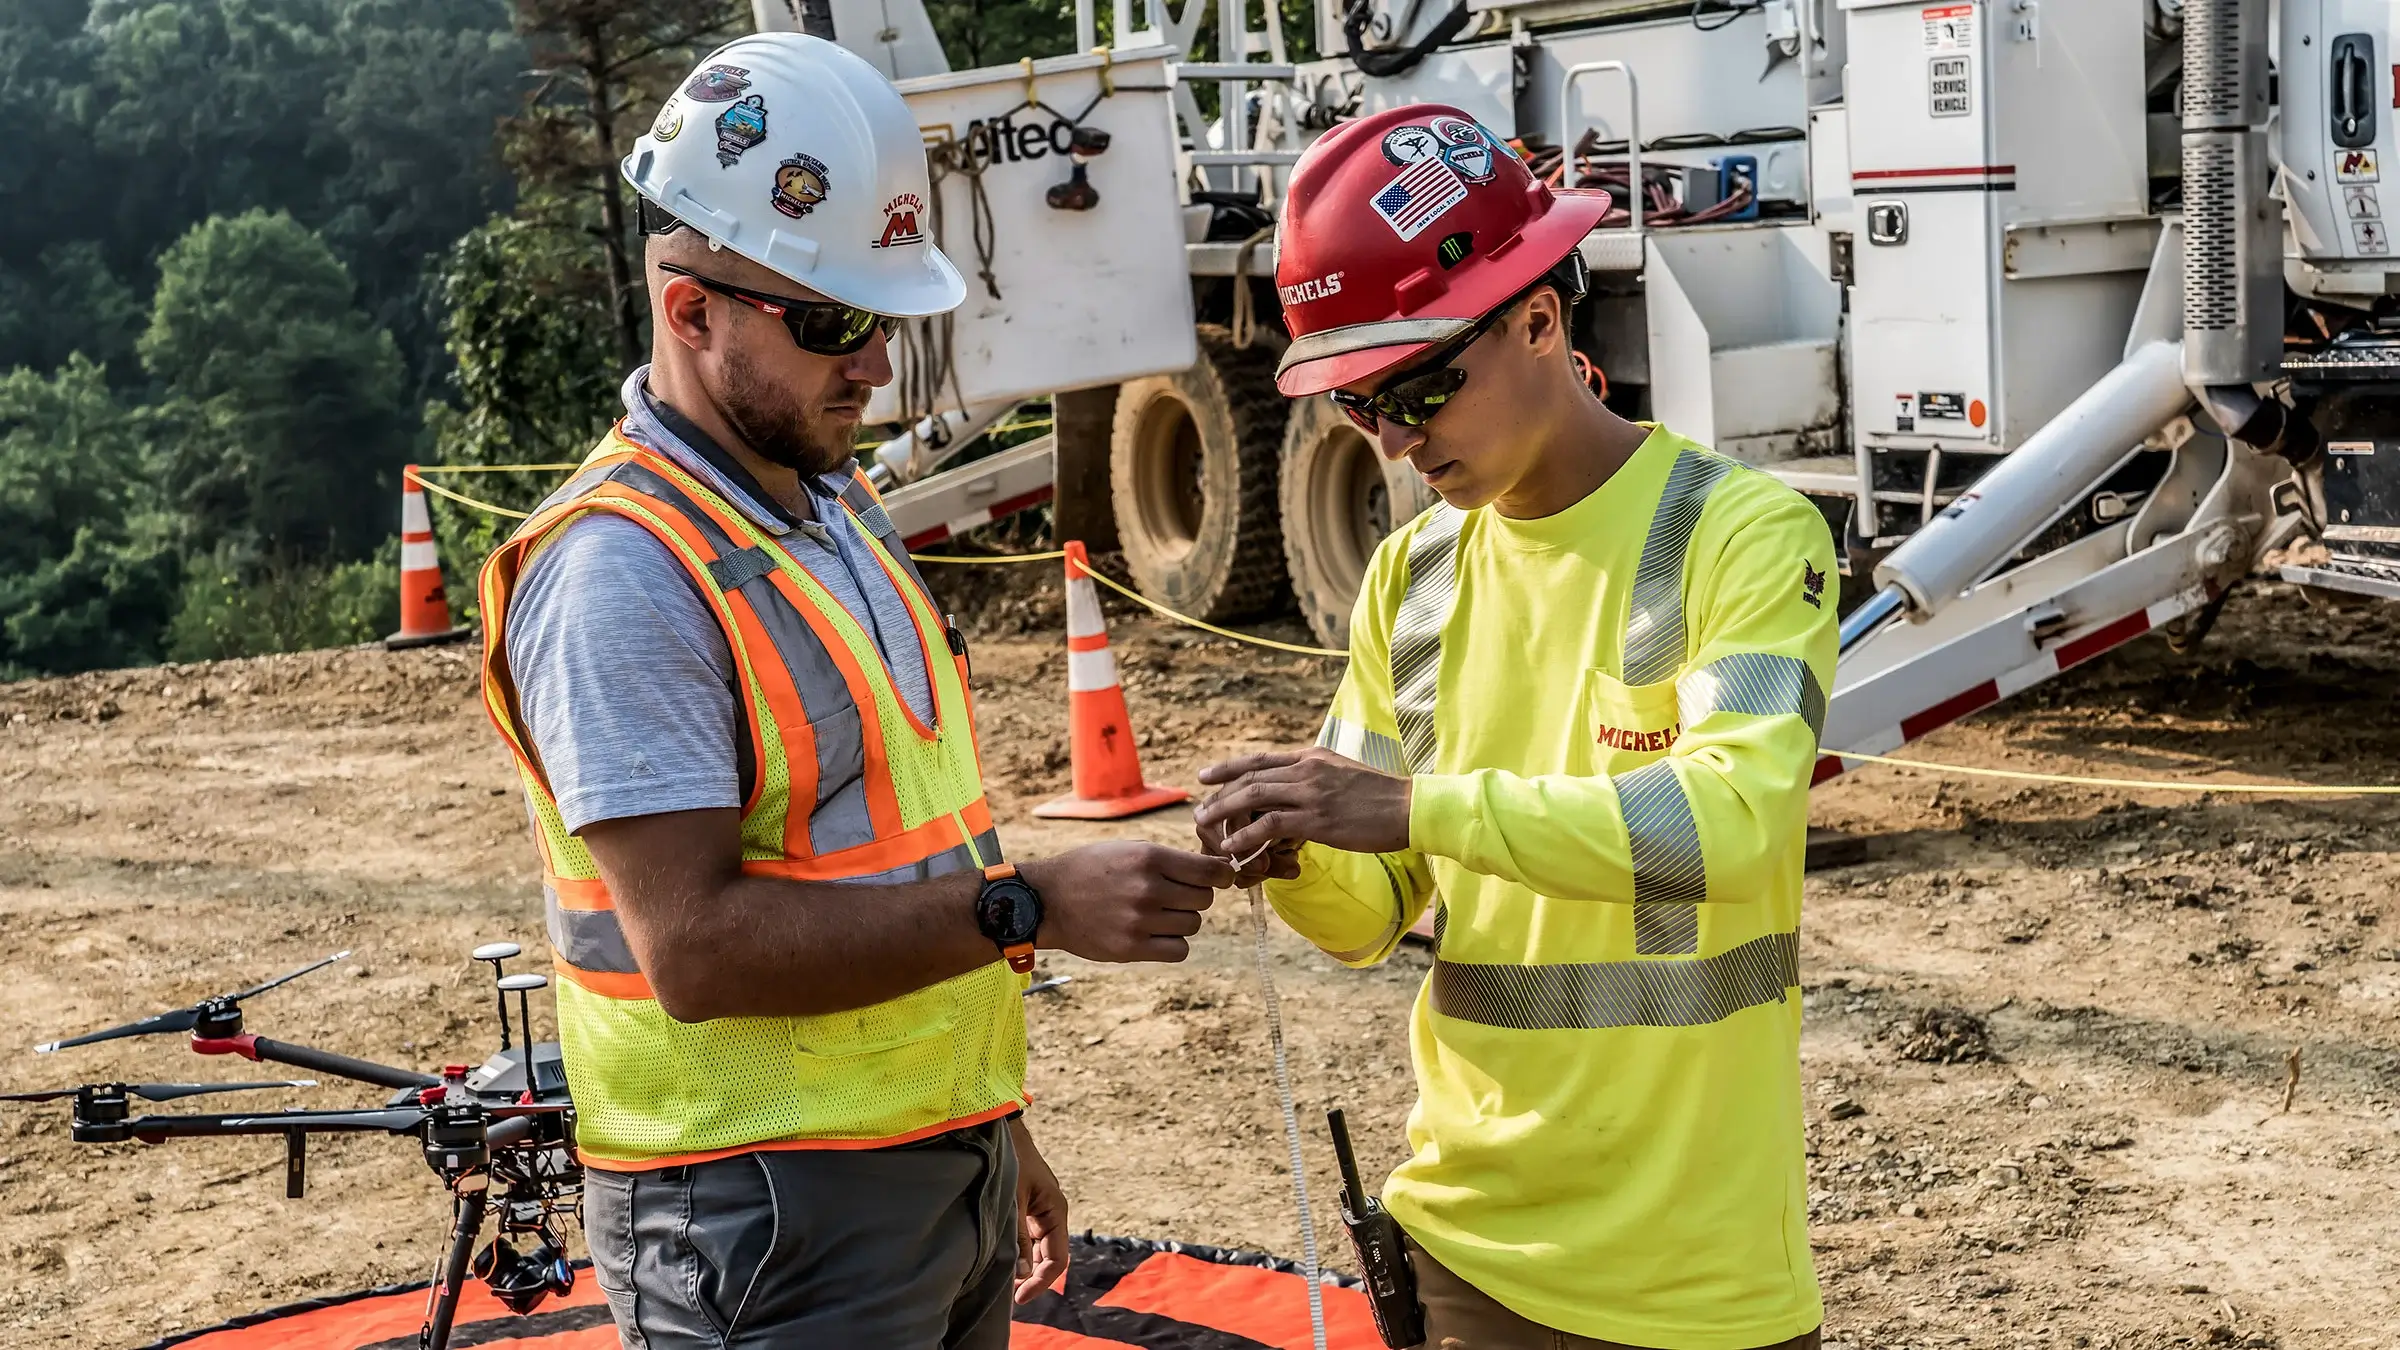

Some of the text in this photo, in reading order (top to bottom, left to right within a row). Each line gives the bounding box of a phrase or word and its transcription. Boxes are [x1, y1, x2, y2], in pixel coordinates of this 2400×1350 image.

[1934, 61, 1964, 76] UTILITY
[1933, 79, 1967, 94] SERVICE
[1934, 97, 1967, 112] VEHICLE
[883, 193, 924, 217] MICHELS
[1430, 204, 1447, 218] LOCAL
